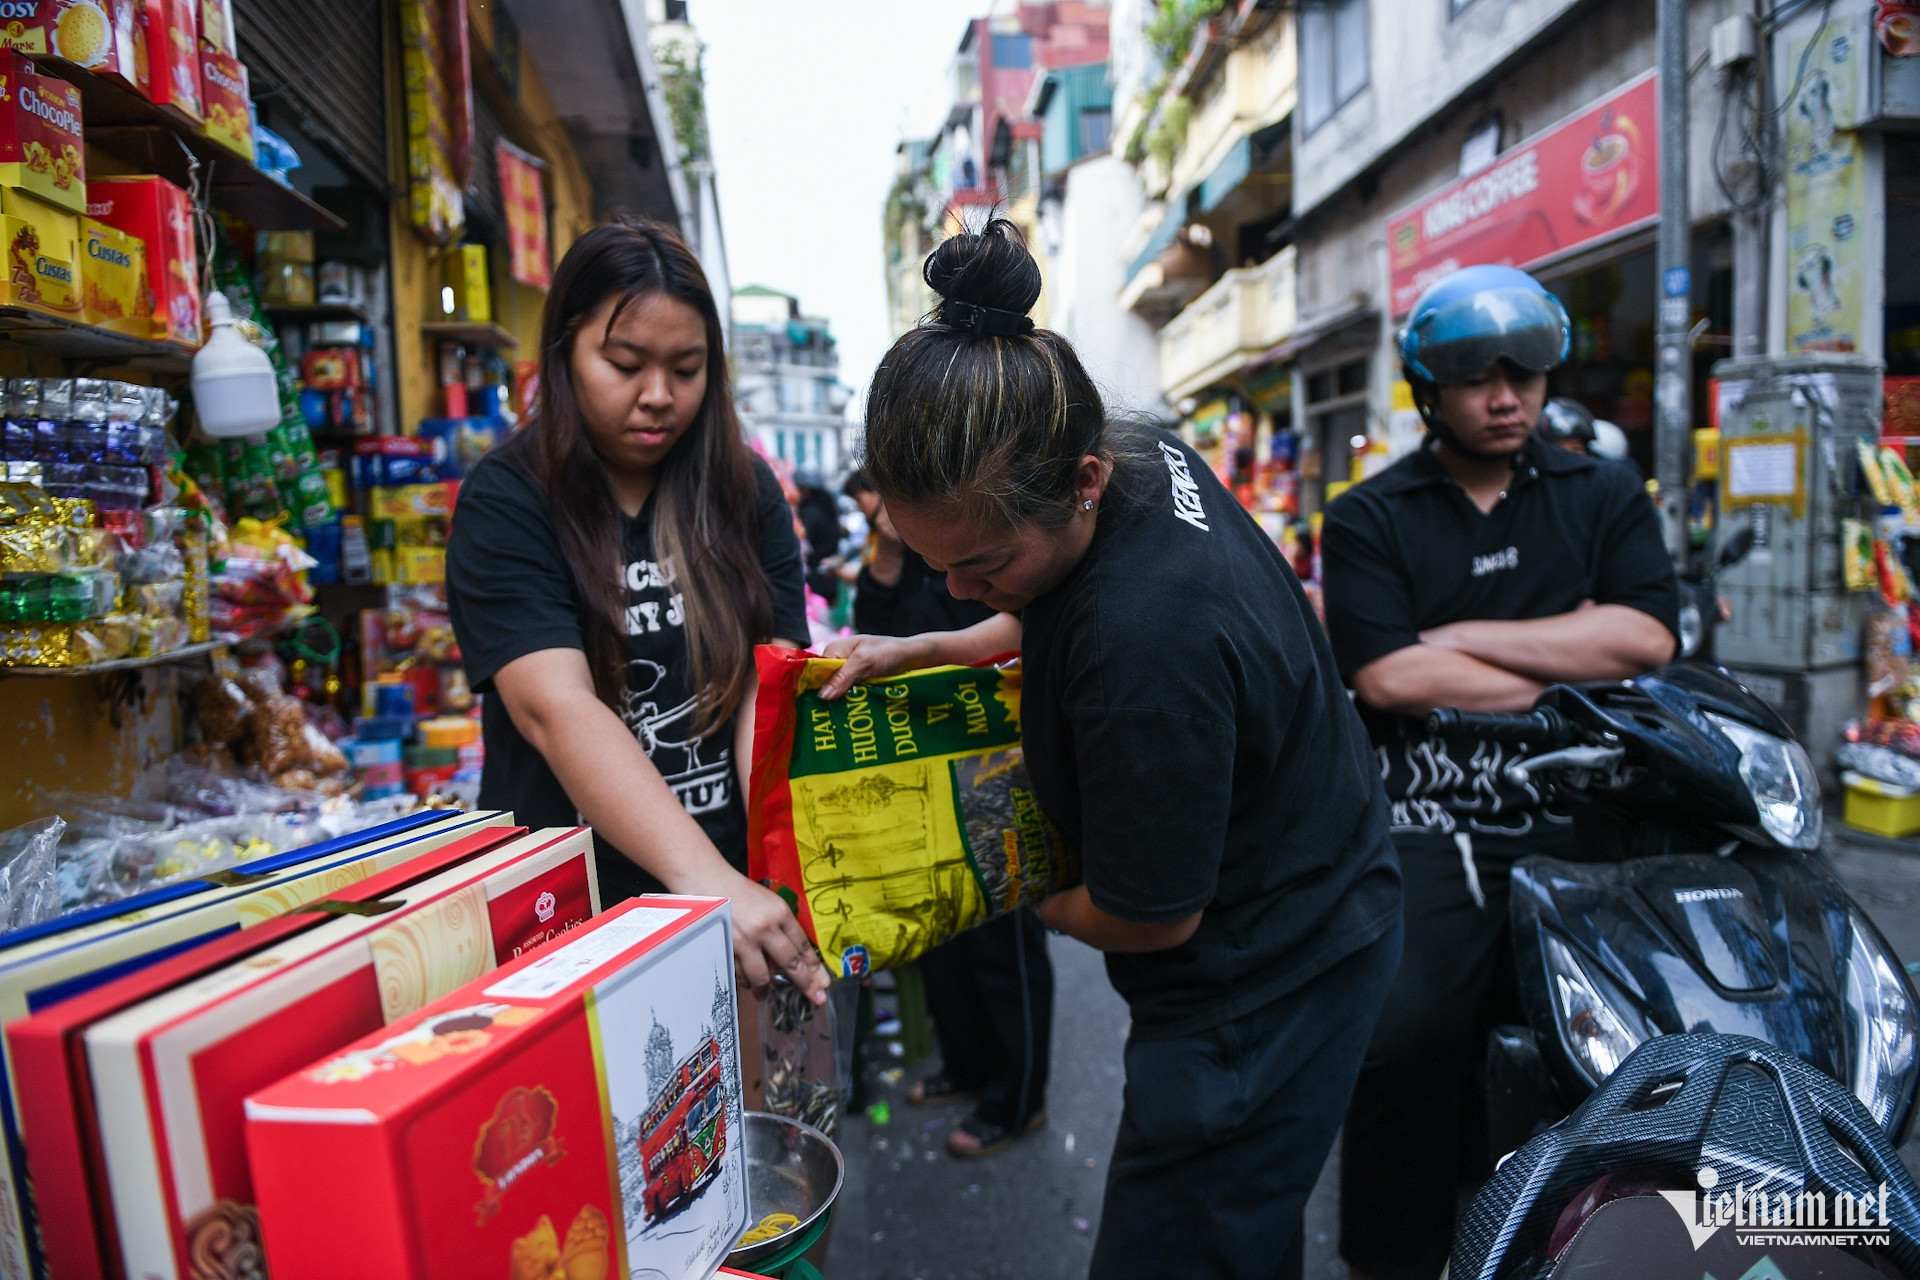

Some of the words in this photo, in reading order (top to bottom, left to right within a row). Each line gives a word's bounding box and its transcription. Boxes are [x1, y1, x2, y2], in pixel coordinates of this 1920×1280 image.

[0, 2, 38, 18] OSY
[1, 37, 35, 51] Marie
[20, 86, 81, 137] ChocoPie
[88, 238, 131, 268] Custas
[35, 256, 72, 283] Custas
[885, 683, 918, 757] DƯƠNG
[927, 702, 954, 725] VỊ
[955, 681, 989, 735] MUỐI
[811, 708, 837, 752] HẠT
[844, 685, 878, 764] HƯỚNG
[1674, 887, 1745, 904] HONDA
